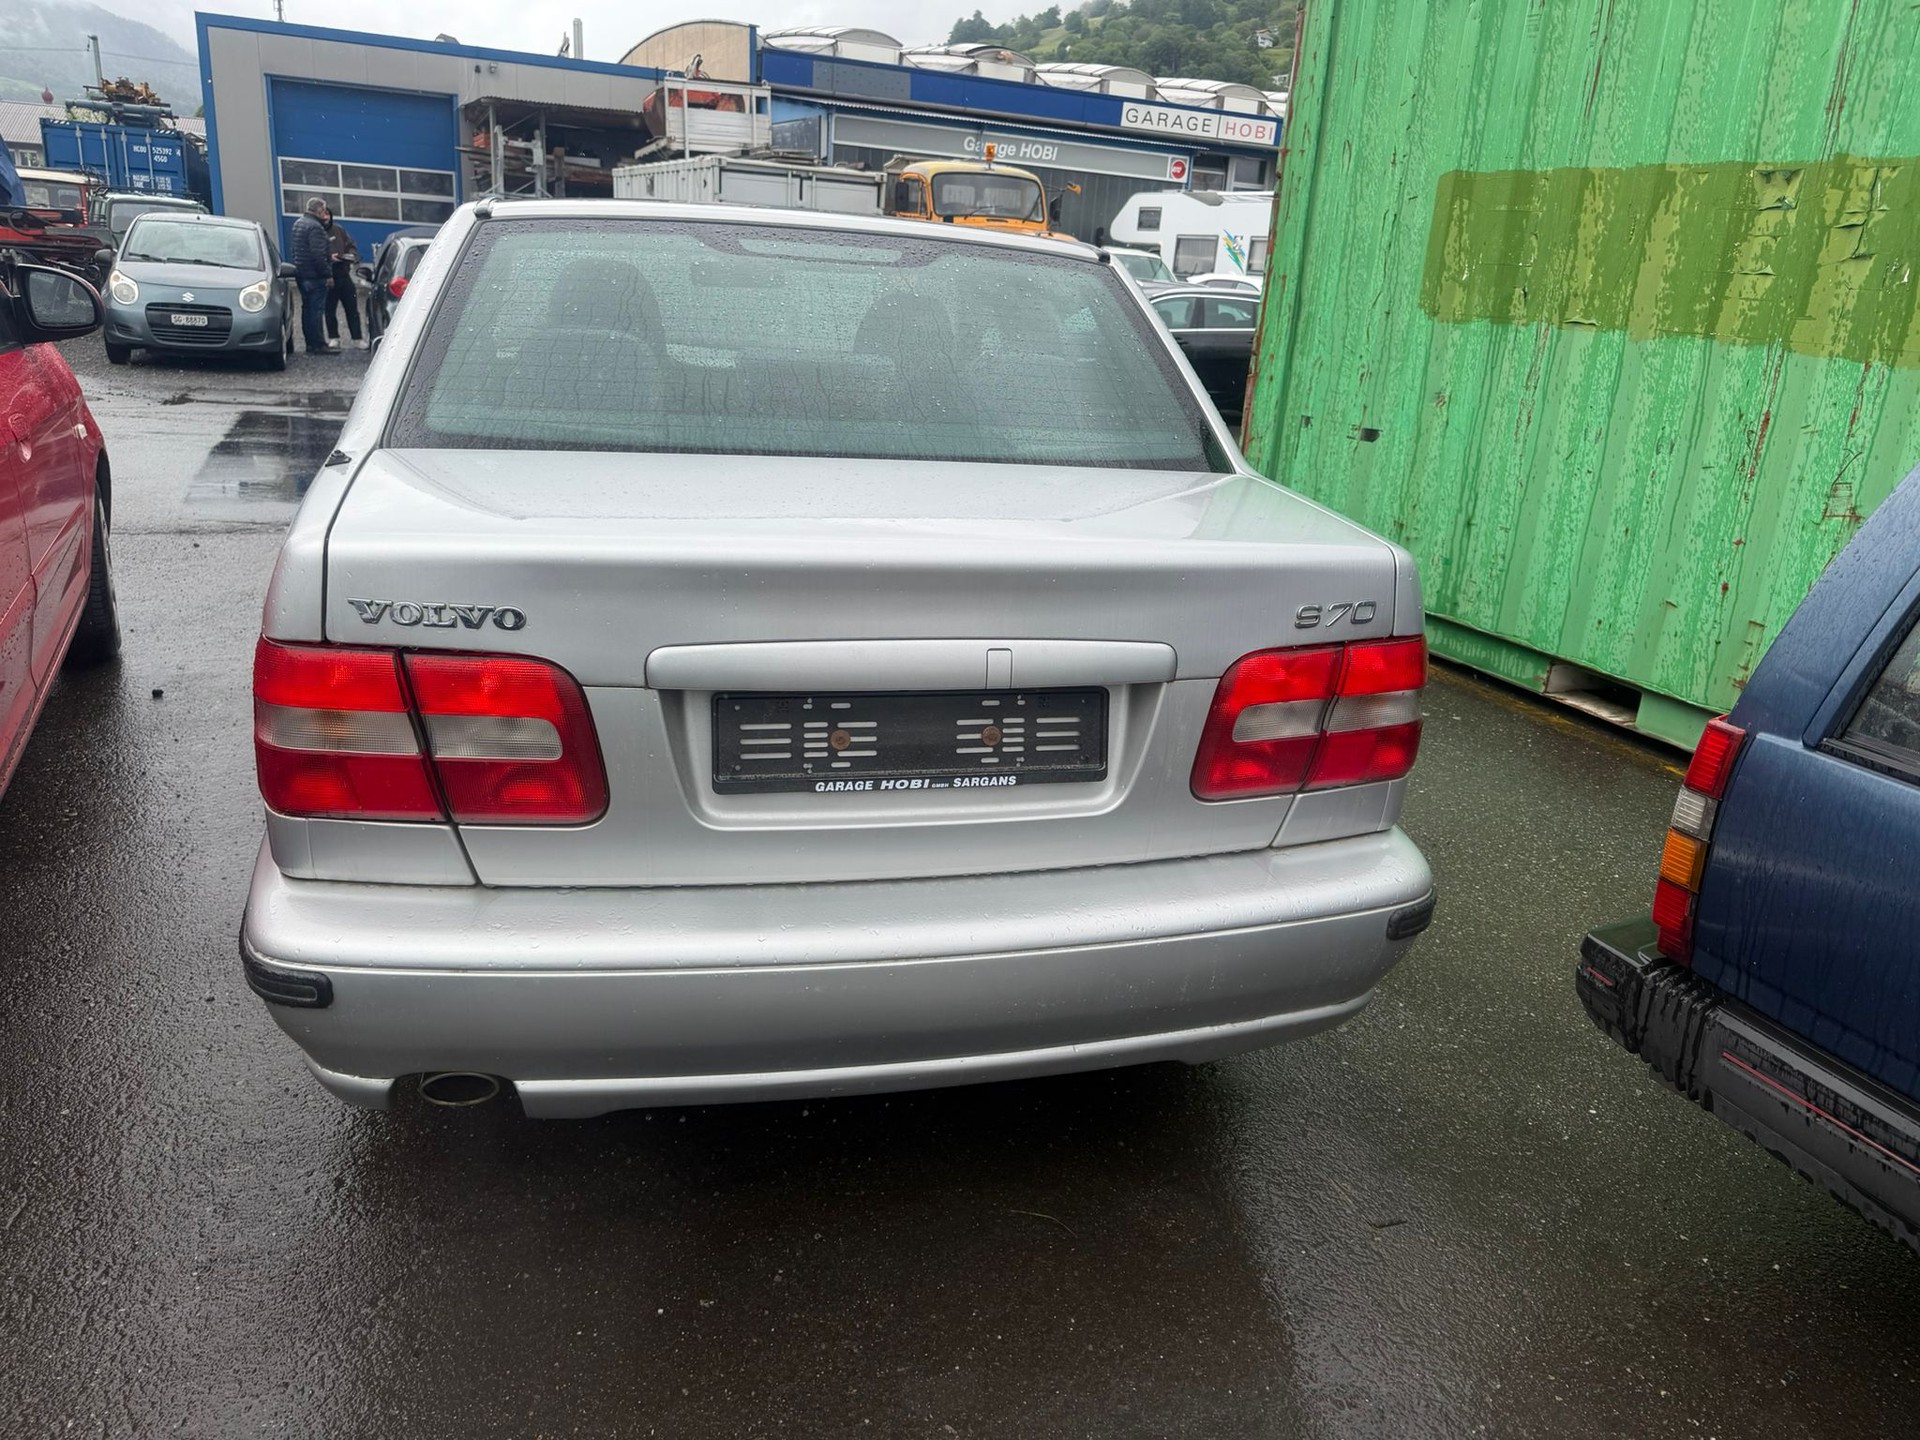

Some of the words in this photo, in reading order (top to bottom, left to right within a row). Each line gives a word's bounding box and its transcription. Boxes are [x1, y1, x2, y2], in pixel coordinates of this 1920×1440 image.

[1125, 108, 1212, 133] GARAGE
[1225, 121, 1273, 140] HOBI
[1019, 142, 1058, 161] HOBI
[347, 597, 527, 631] VOLVO
[1294, 600, 1377, 629] S70
[814, 780, 874, 792] GARAGE
[879, 778, 930, 790] HOBI
[953, 775, 1017, 788] SARGANS
